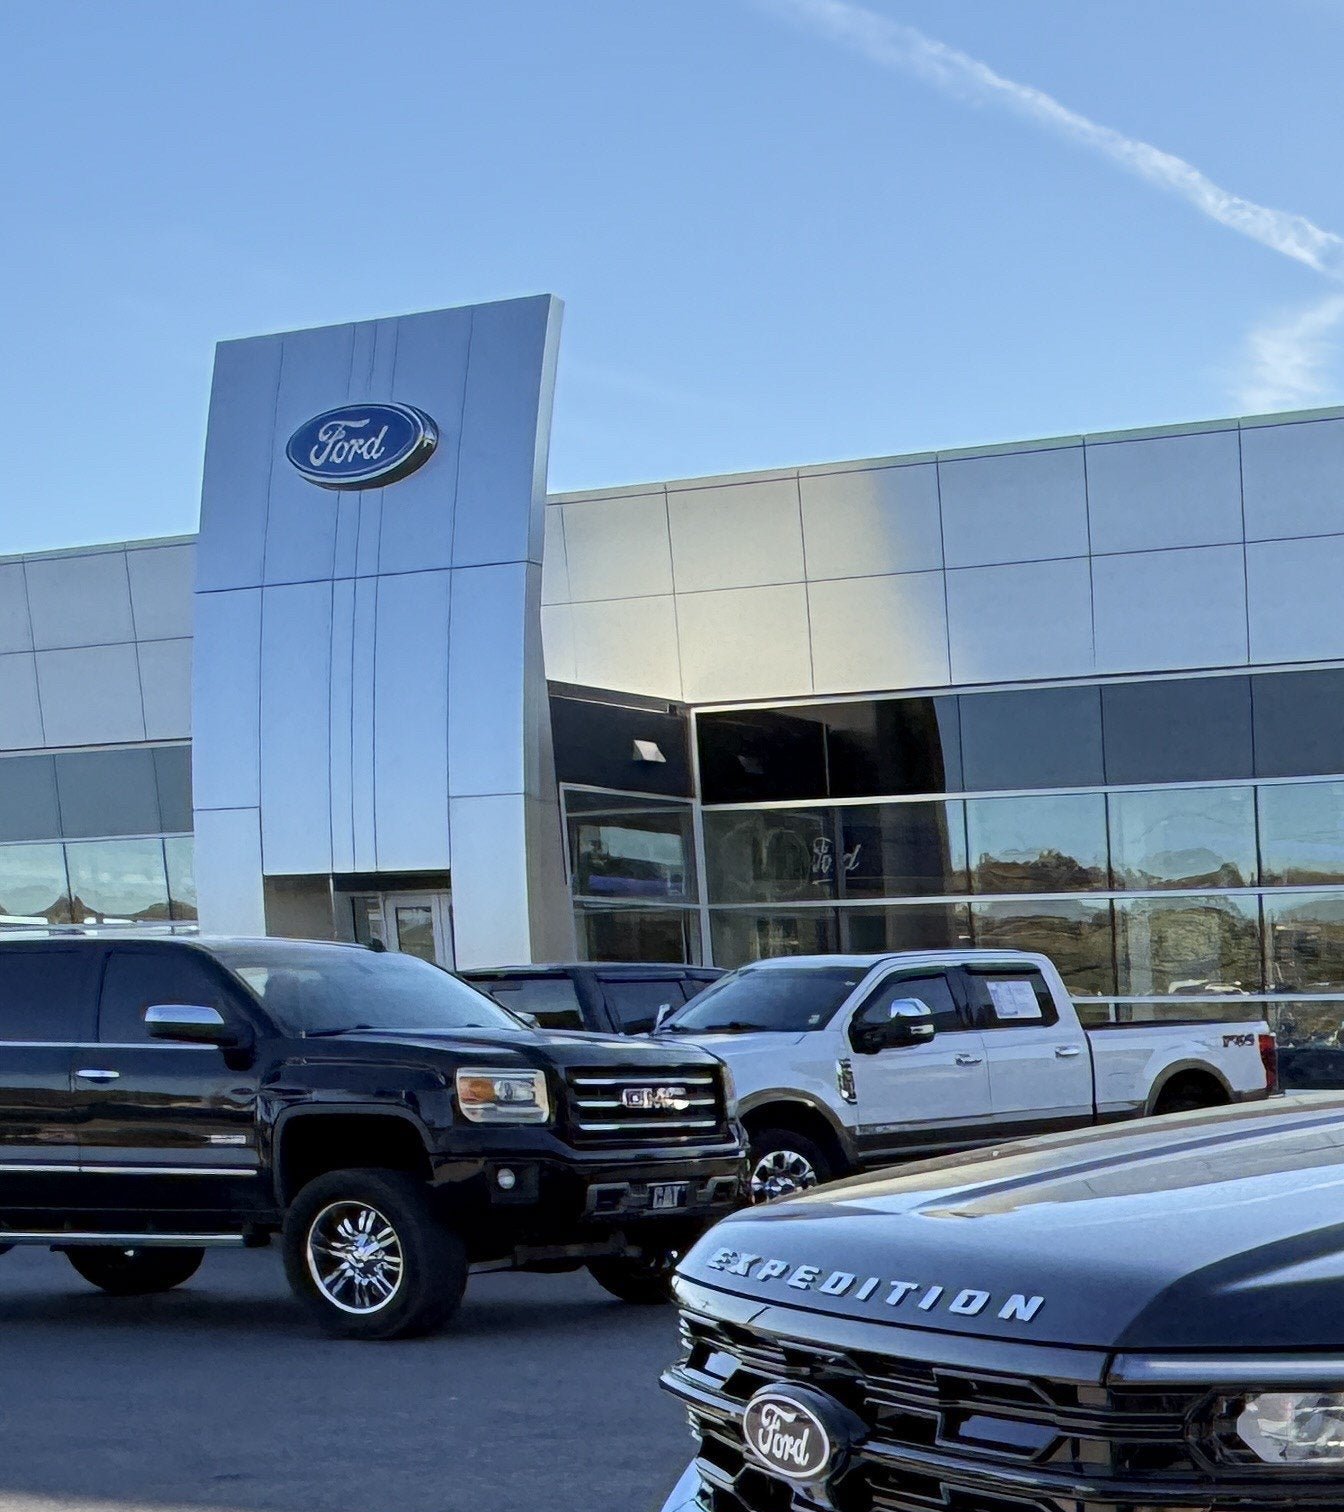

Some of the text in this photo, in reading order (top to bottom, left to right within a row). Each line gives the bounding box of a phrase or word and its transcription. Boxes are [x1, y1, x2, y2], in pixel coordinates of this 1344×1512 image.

[309, 418, 391, 467] Ford
[706, 1247, 1045, 1323] EXPEDITION
[757, 1403, 810, 1467] Ford
